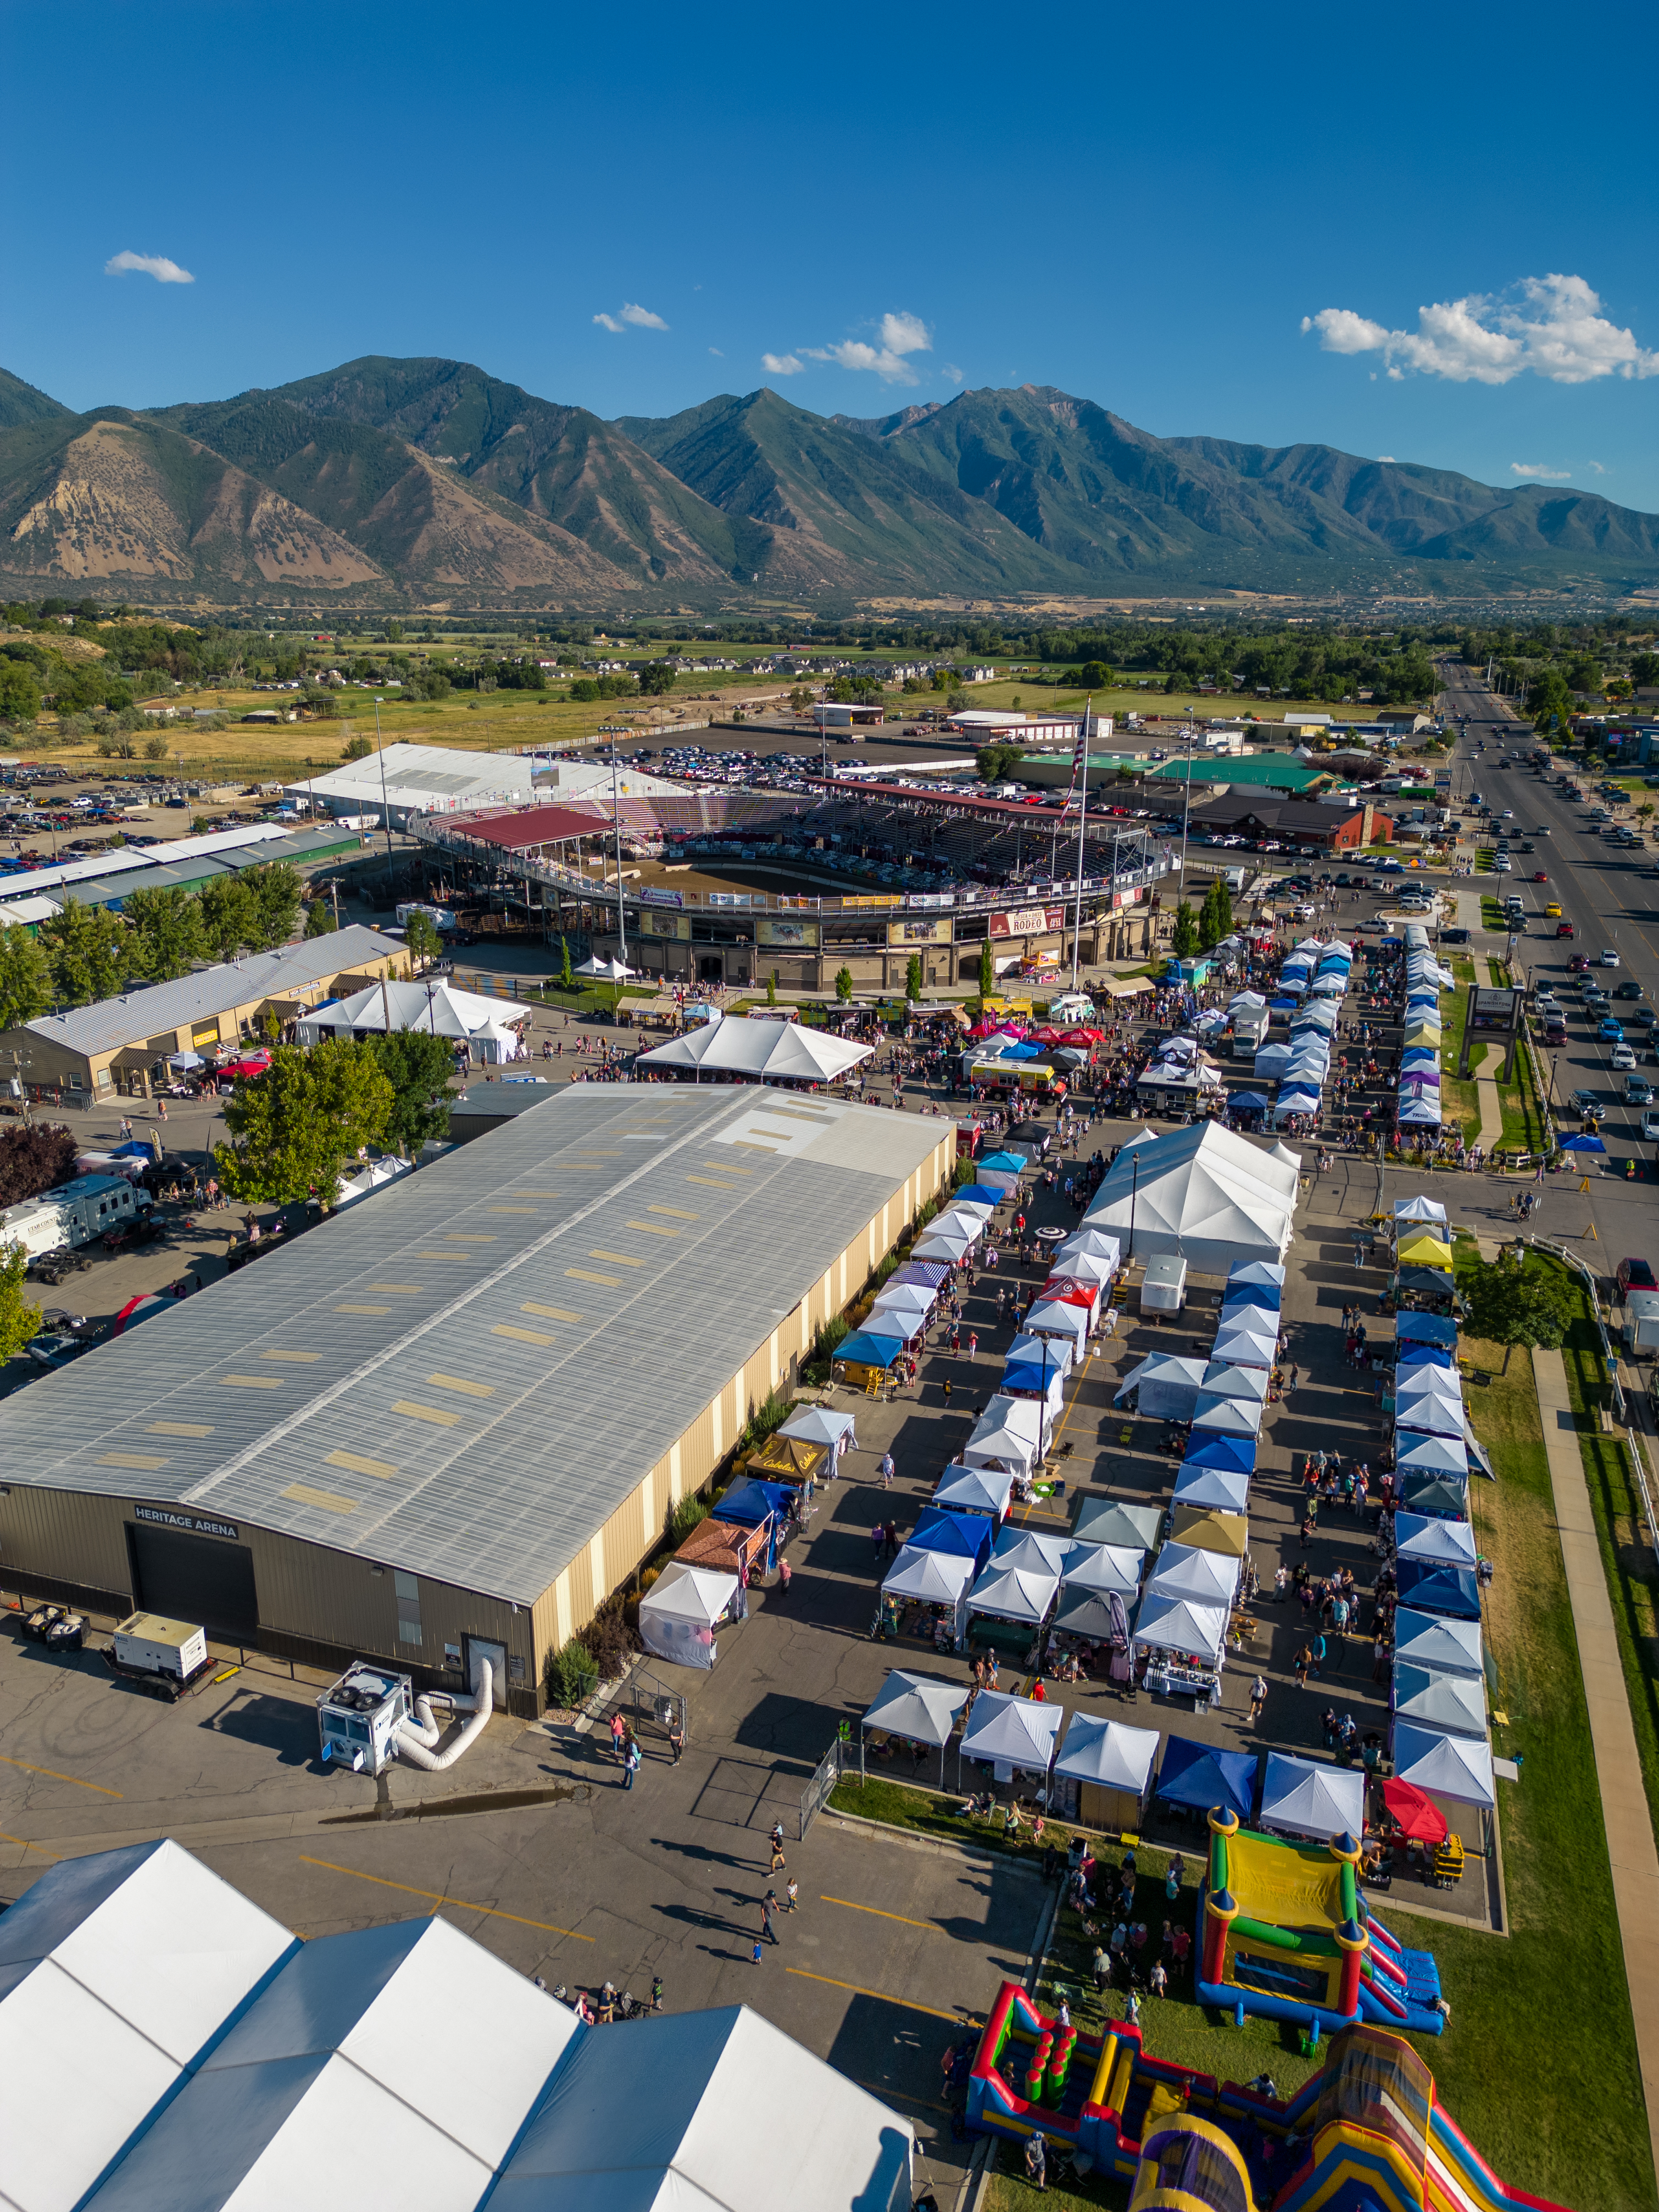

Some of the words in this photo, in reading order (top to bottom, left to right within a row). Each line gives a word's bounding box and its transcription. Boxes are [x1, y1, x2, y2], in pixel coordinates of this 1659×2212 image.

[1014, 919, 1042, 931] RODEO
[27, 1223, 40, 1232] UTAH
[40, 1216, 59, 1227] COUNTY
[764, 1459, 795, 1472] Cabela's
[799, 1452, 818, 1469] Cabela's
[136, 1507, 192, 1528] HERITAGE
[195, 1520, 236, 1537] ARENA
